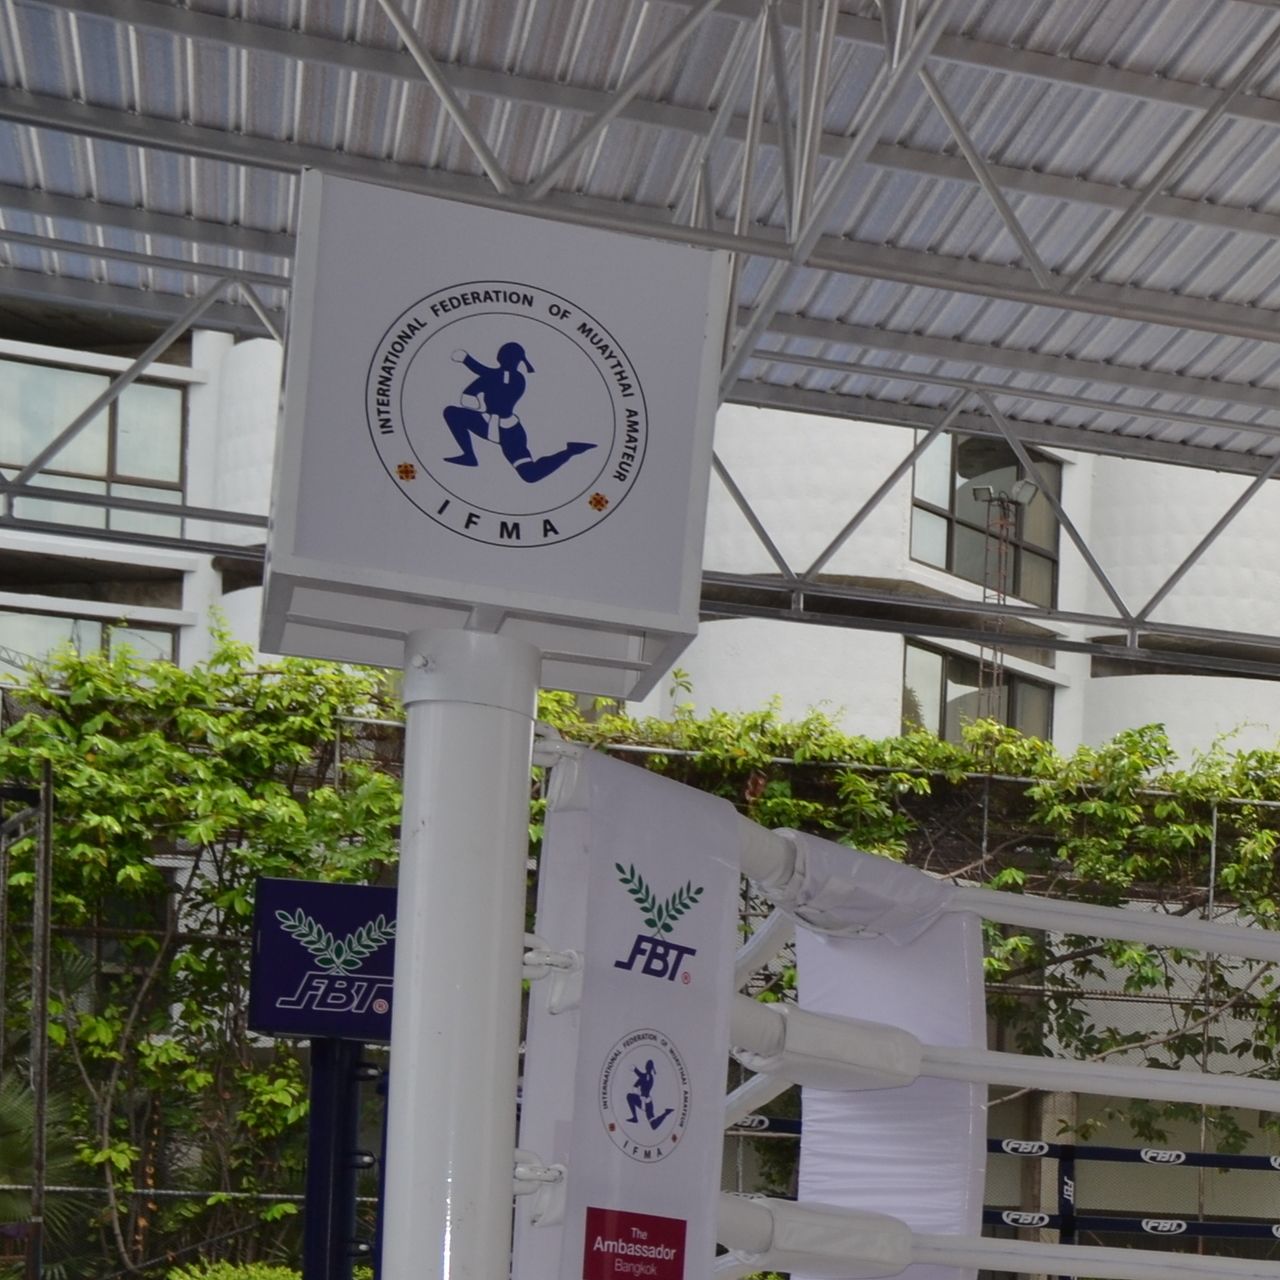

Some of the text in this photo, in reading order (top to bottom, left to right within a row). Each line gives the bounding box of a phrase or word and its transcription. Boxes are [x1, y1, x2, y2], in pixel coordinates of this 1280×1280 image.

[376, 290, 640, 483] INTERNATIONAL FEDERATION OF MUAYTHAI AMATEUR
[437, 499, 559, 540] IFMA
[614, 934, 697, 982] FBT
[593, 1236, 676, 1260] Ambassador
[631, 1227, 648, 1240] The
[614, 1259, 657, 1276] Bangkok
